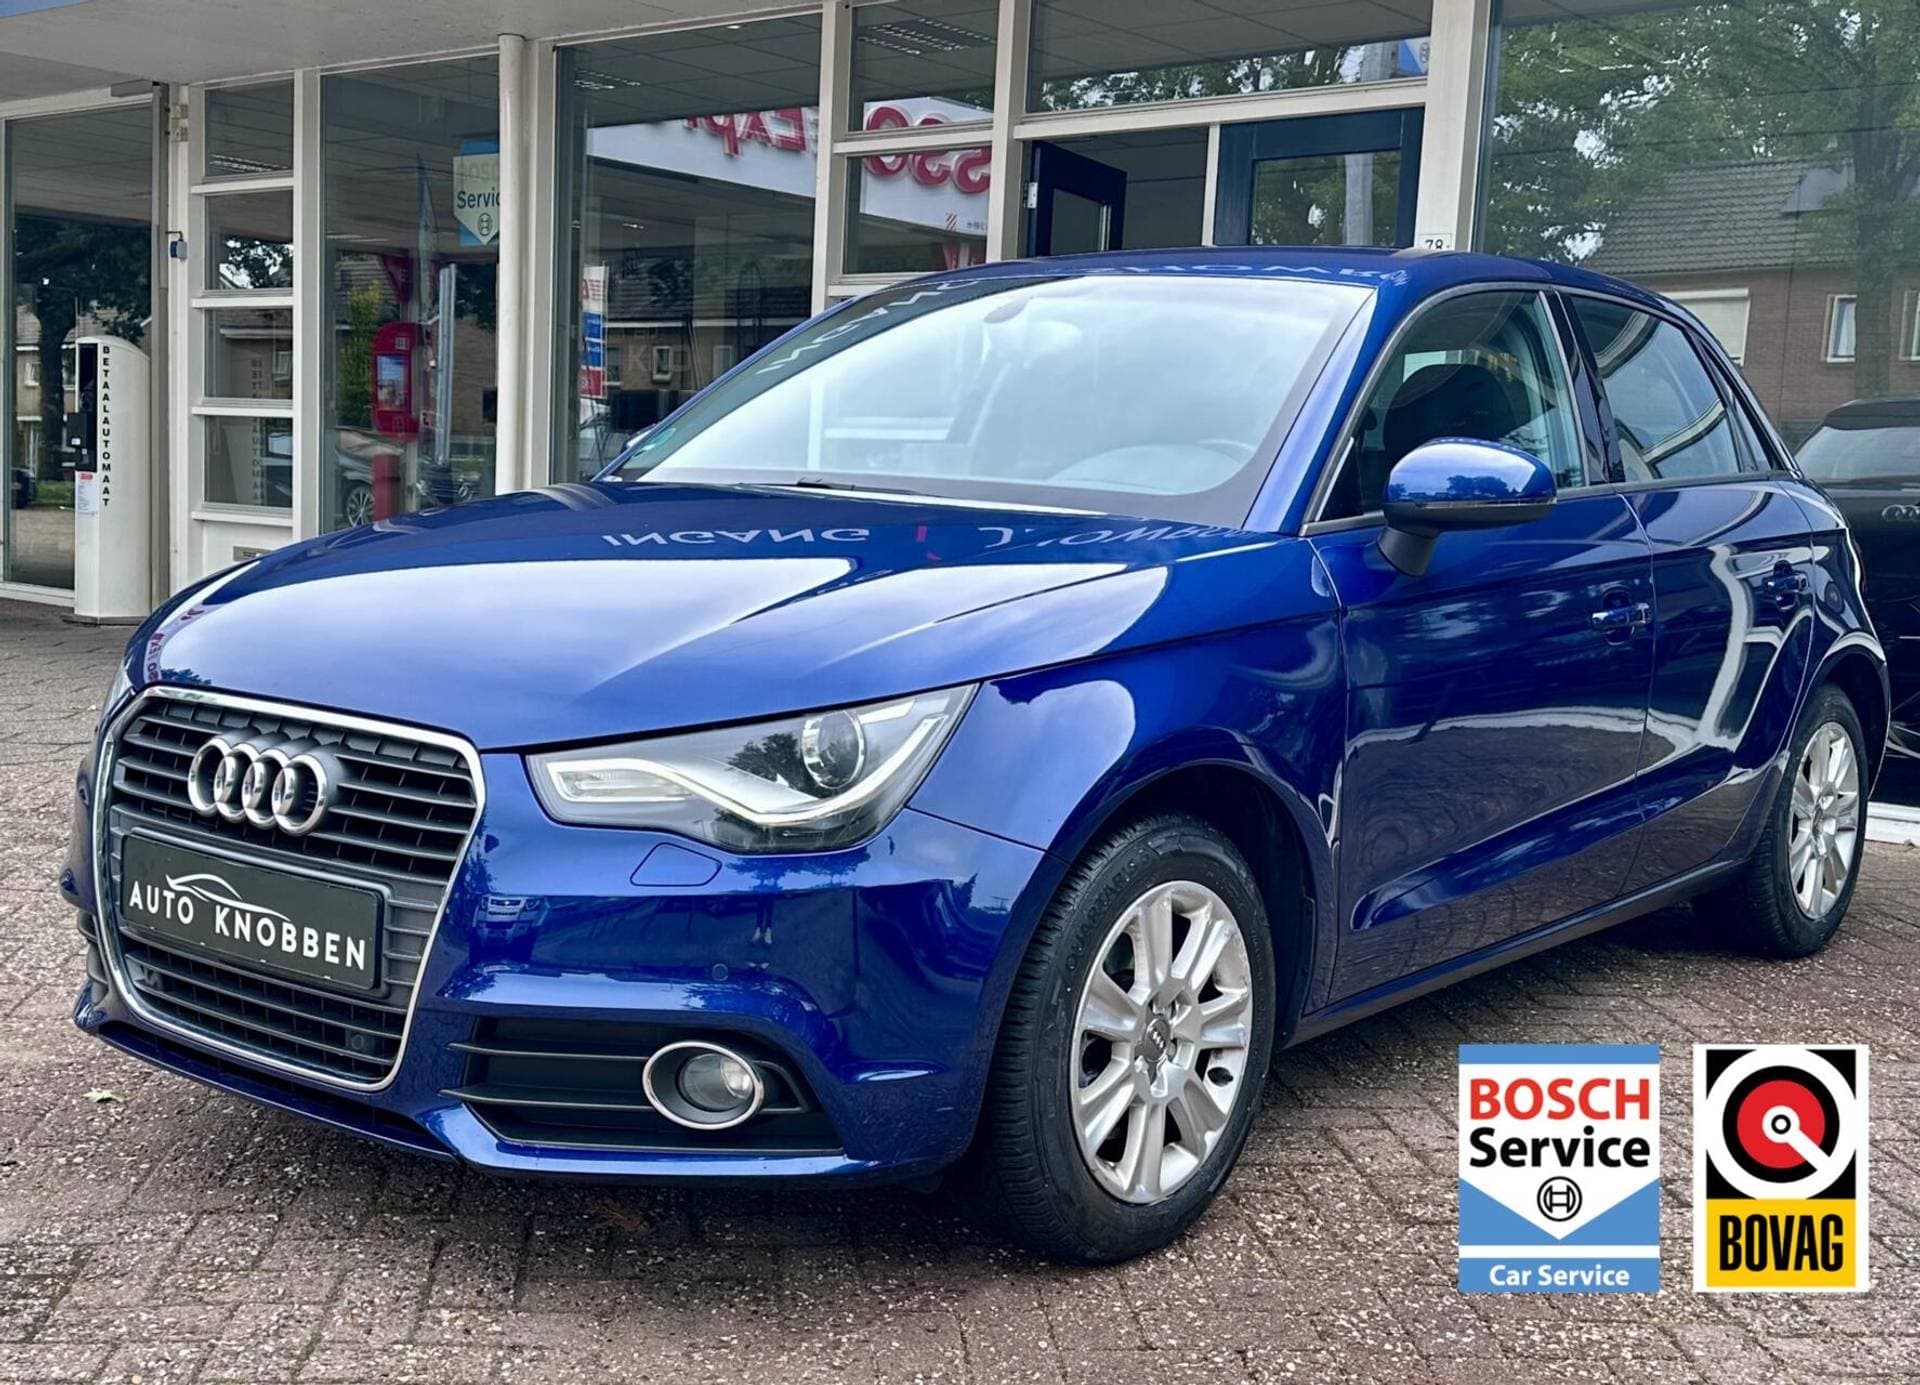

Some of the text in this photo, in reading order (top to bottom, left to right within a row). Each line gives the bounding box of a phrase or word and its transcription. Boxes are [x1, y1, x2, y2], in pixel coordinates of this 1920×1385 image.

[102, 345, 112, 507] BETAALAUTOMAAT
[128, 880, 367, 972] AUTO KNOBBEN
